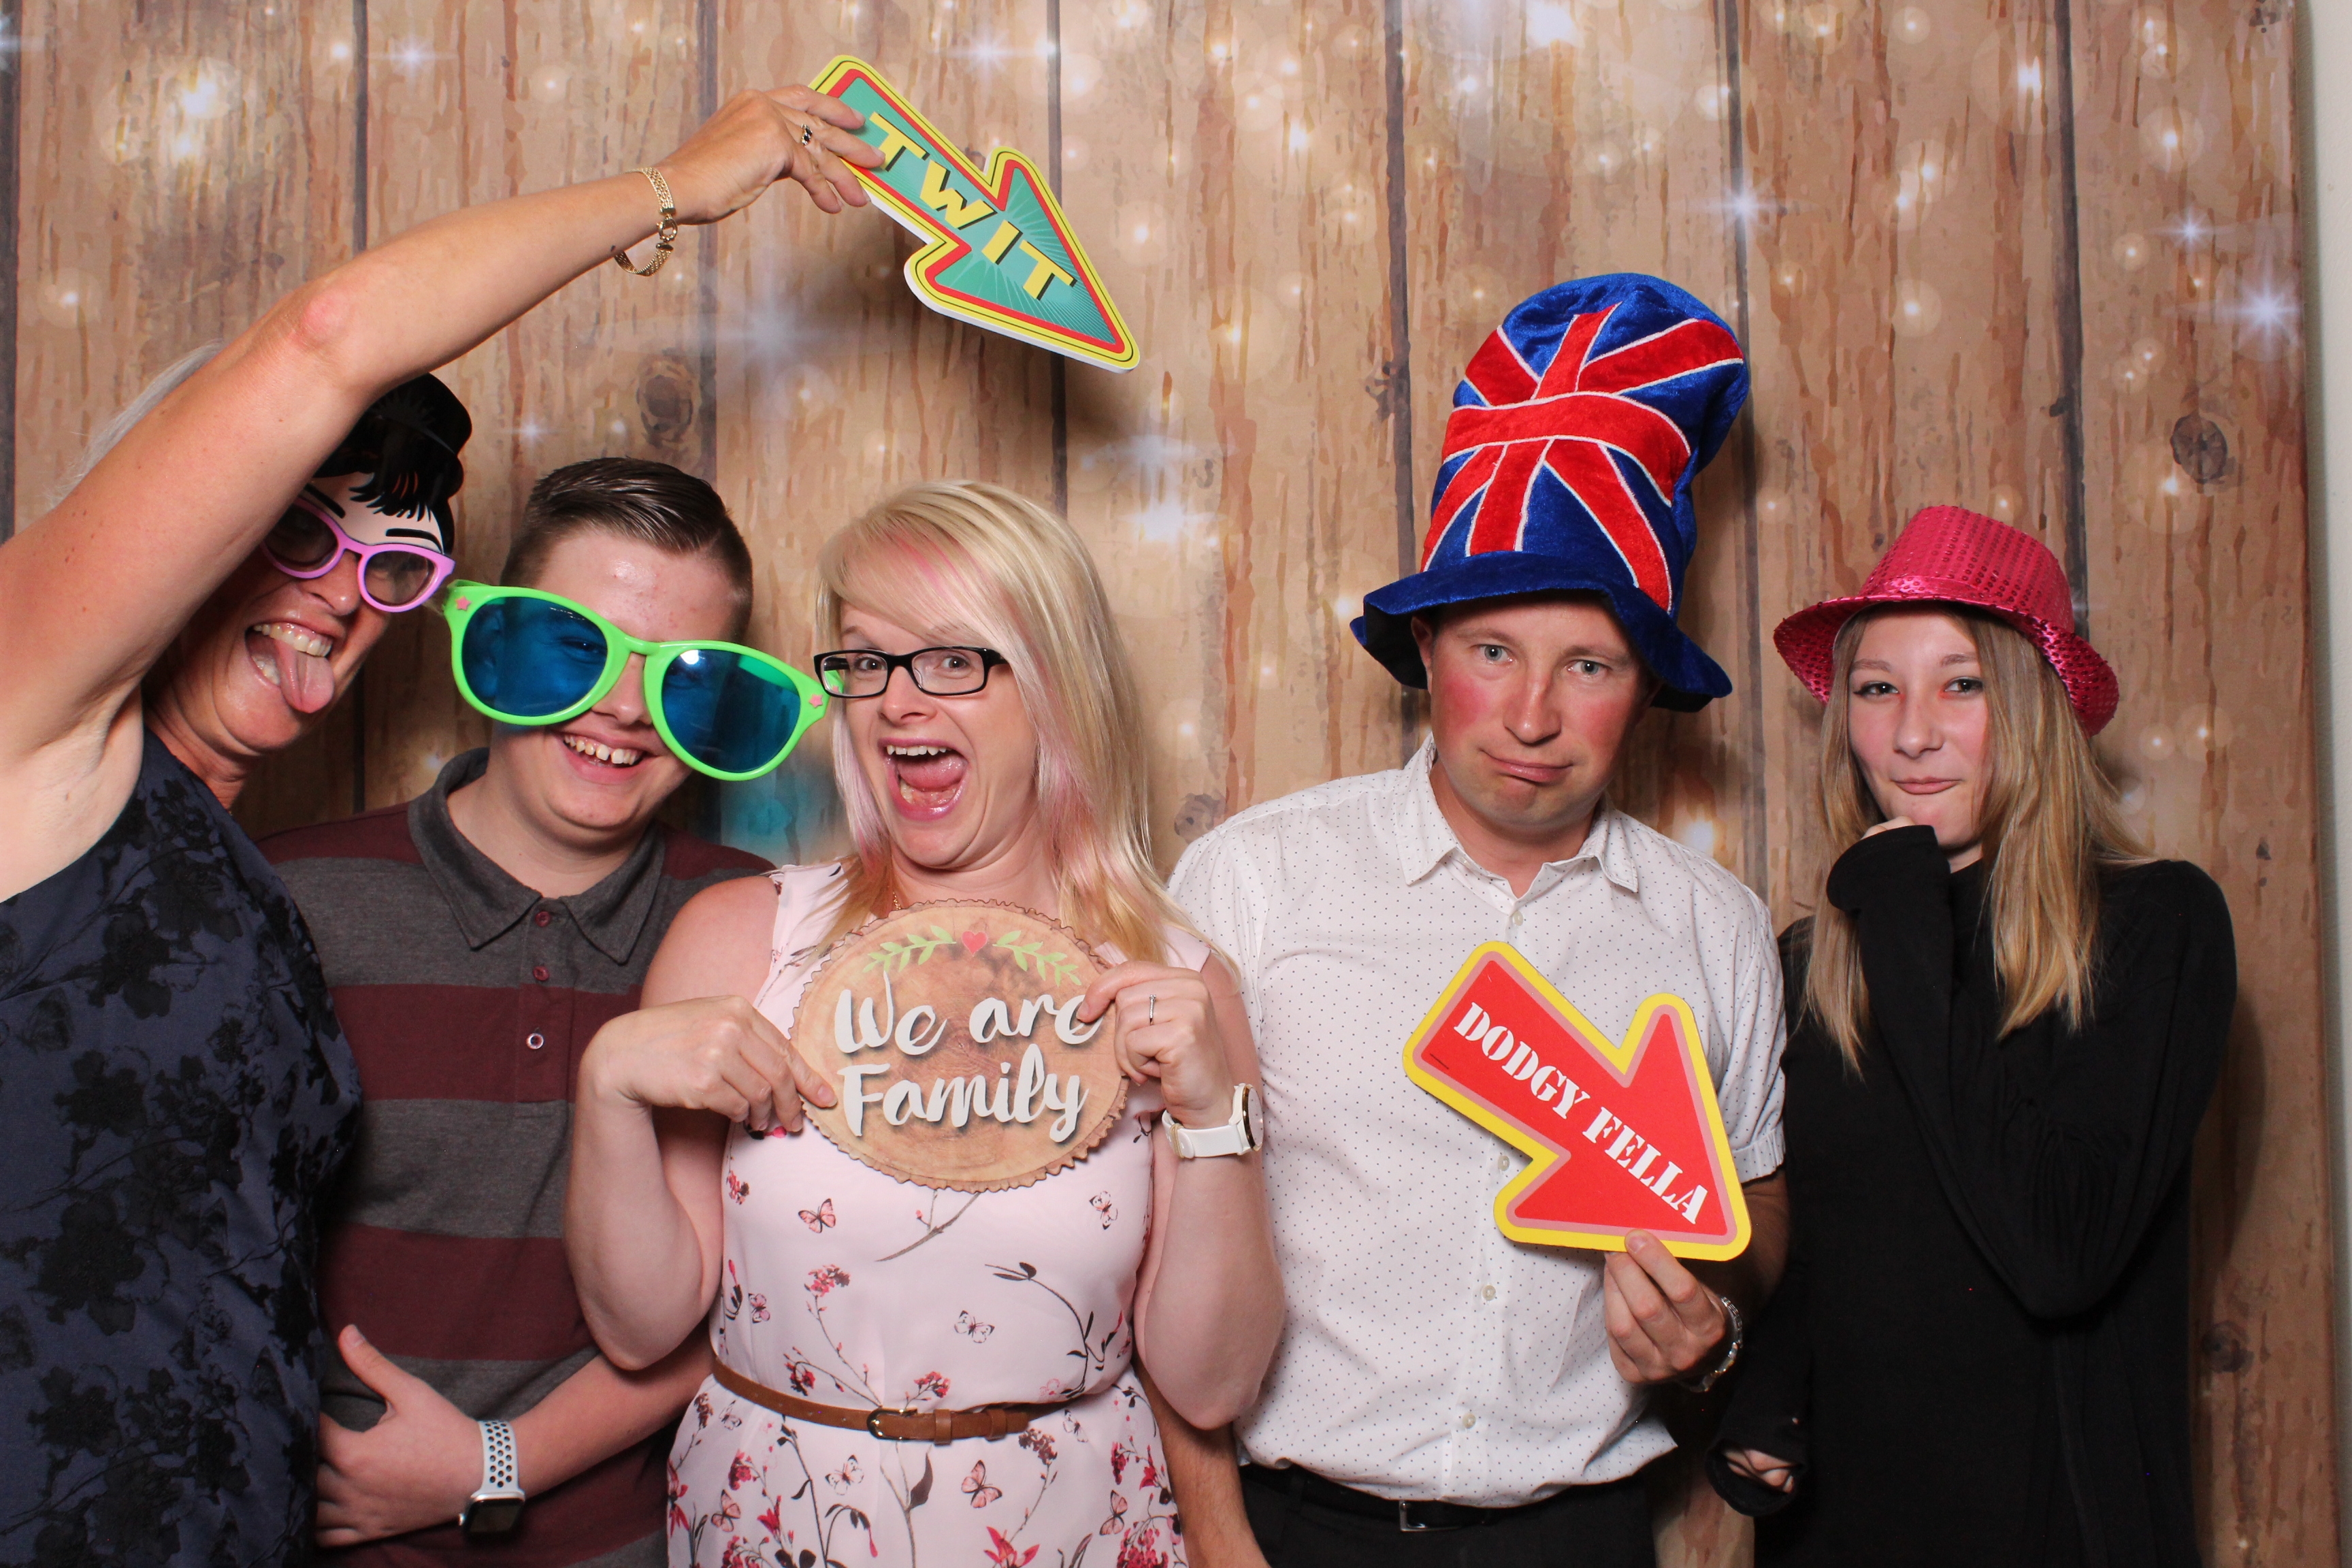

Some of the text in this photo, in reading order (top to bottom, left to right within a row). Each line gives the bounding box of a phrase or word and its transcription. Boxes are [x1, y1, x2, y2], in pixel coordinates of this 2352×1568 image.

[870, 112, 1077, 301] TWIT
[834, 971, 1104, 1056] We are
[837, 1043, 1089, 1142] Family
[1454, 1002, 1708, 1224] DODGY FELLA
